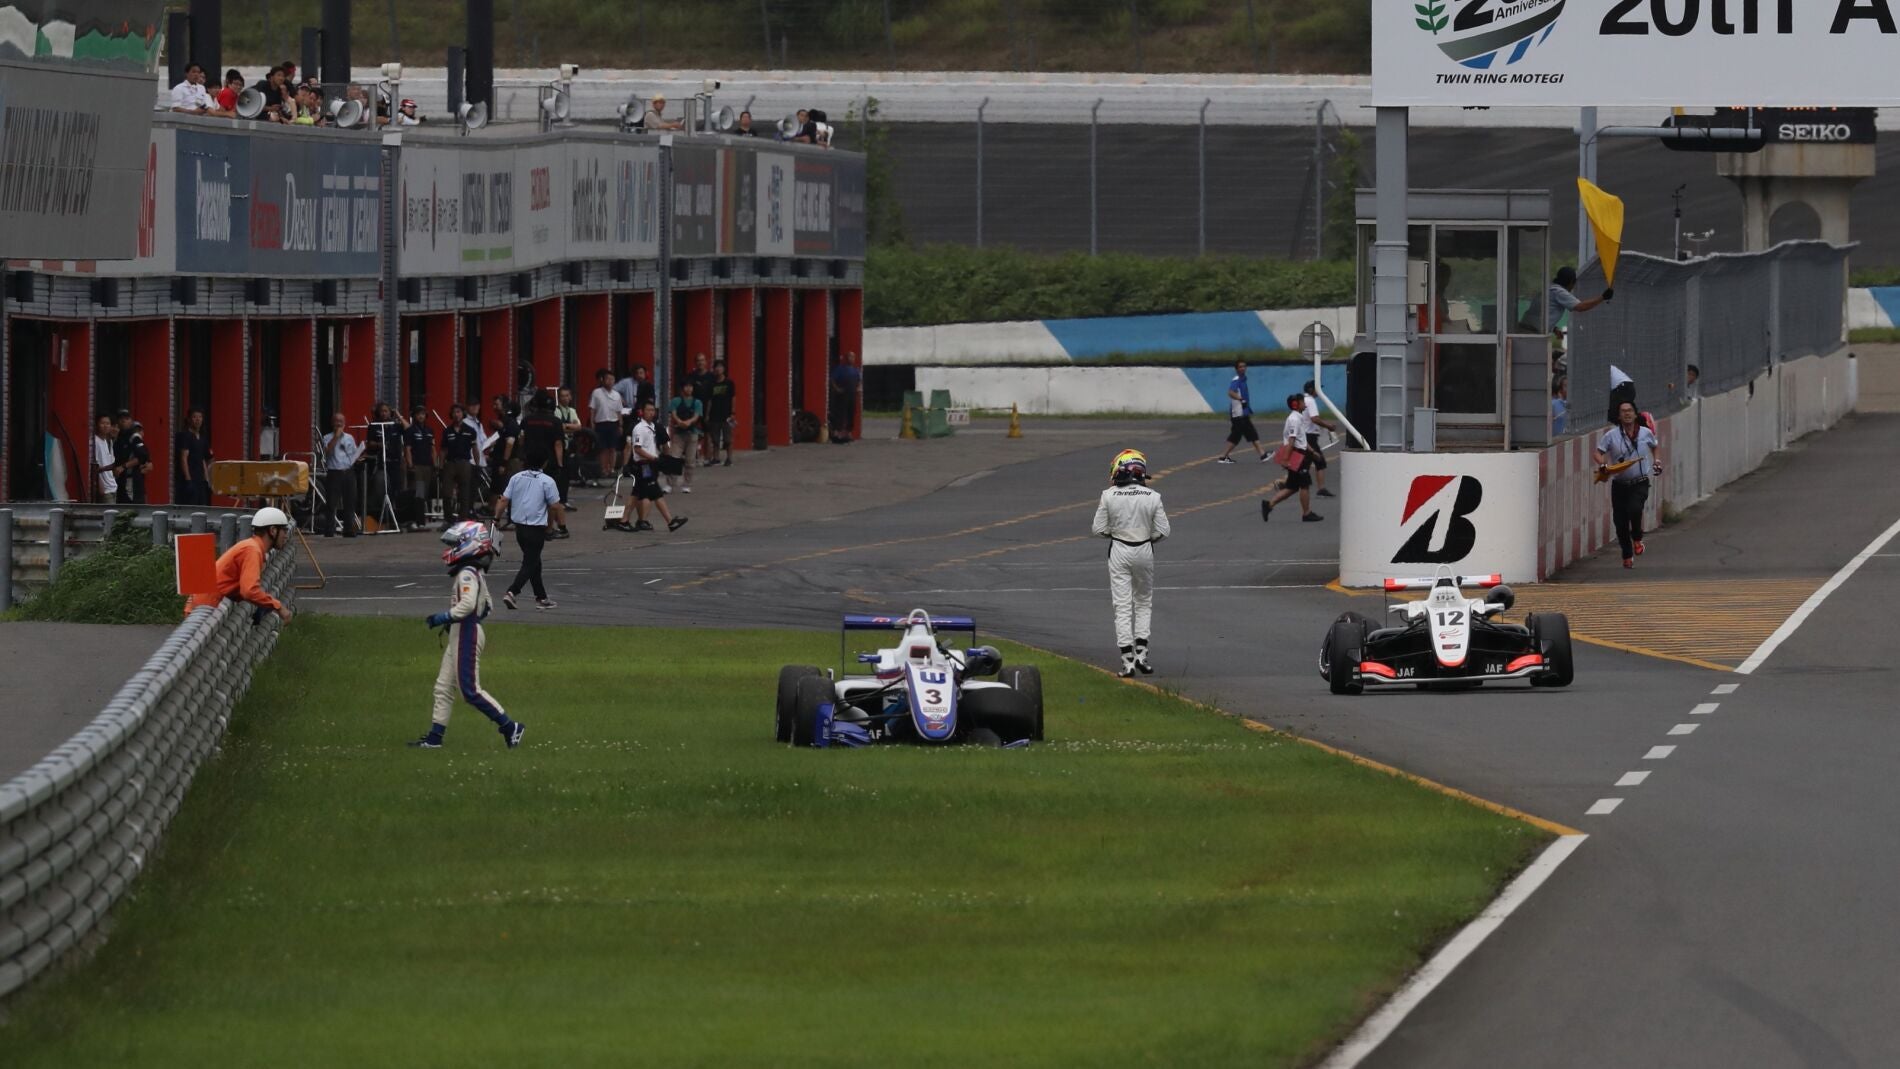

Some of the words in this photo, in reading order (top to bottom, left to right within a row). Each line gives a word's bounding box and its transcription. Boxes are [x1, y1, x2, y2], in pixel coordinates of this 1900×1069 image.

[1436, 73, 1471, 84] TWIN
[1474, 73, 1508, 84] RING
[1510, 73, 1564, 84] MOTEGI
[1778, 123, 1851, 141] SEIKO
[1435, 610, 1465, 627] 12
[1396, 667, 1415, 677] JAF
[1485, 663, 1503, 674] JAF
[925, 688, 943, 705] 3
